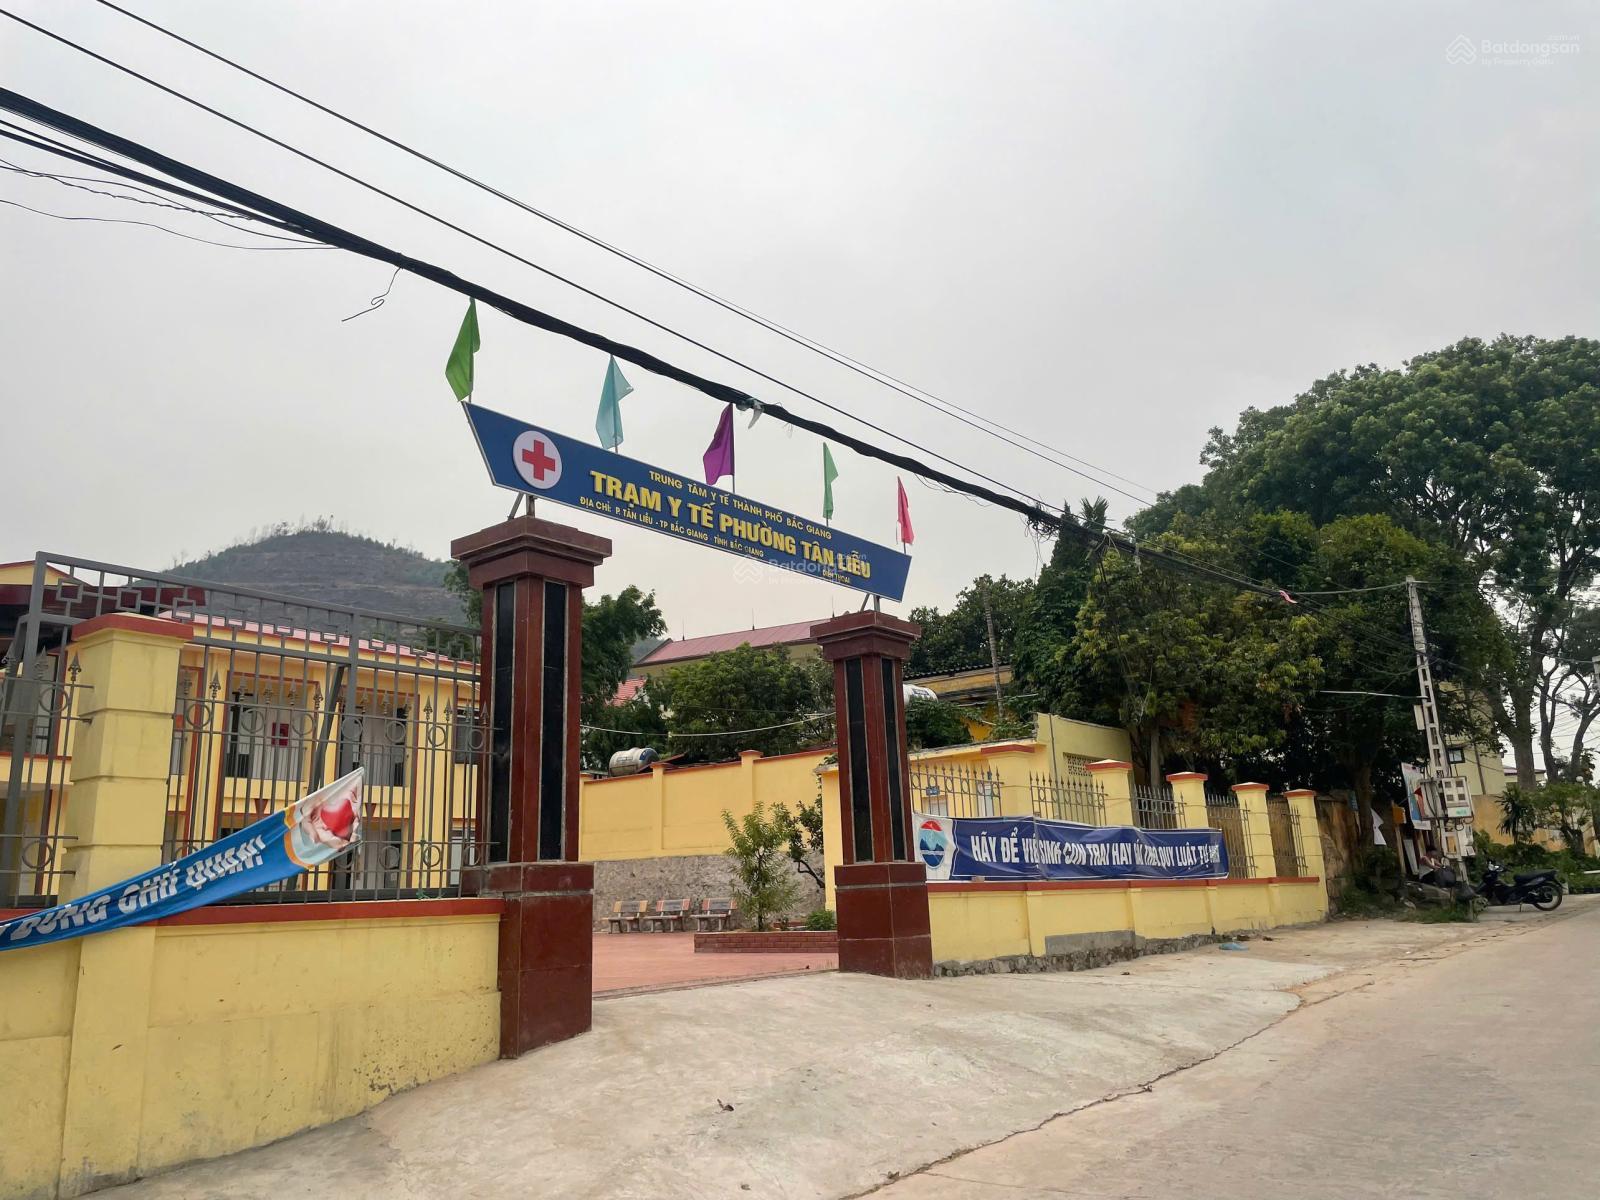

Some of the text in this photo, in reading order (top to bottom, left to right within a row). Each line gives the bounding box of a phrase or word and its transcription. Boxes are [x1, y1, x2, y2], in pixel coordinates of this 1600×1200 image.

[580, 496, 594, 509] ĐỊA
[659, 519, 668, 529] TP
[670, 520, 685, 534] BẮC
[687, 529, 709, 541] GIANG
[590, 470, 871, 579] TRẠM Y TẾ PHƯỜNG TÂN LIỄU
[649, 470, 832, 540] TRUNG TÂM Y TẾ THÀNH PHỐ BẮC GIANG
[970, 830, 997, 863] HÃY
[1000, 826, 1020, 863] ĐỂ
[1022, 833, 1039, 869] VIỆ
[1038, 840, 1062, 864] SINH
[1063, 842, 1087, 865] CON
[1086, 843, 1110, 866] TRAI
[1112, 843, 1132, 866] HAY
[1159, 846, 1175, 870] QUY
[1176, 841, 1198, 870] LUẬT
